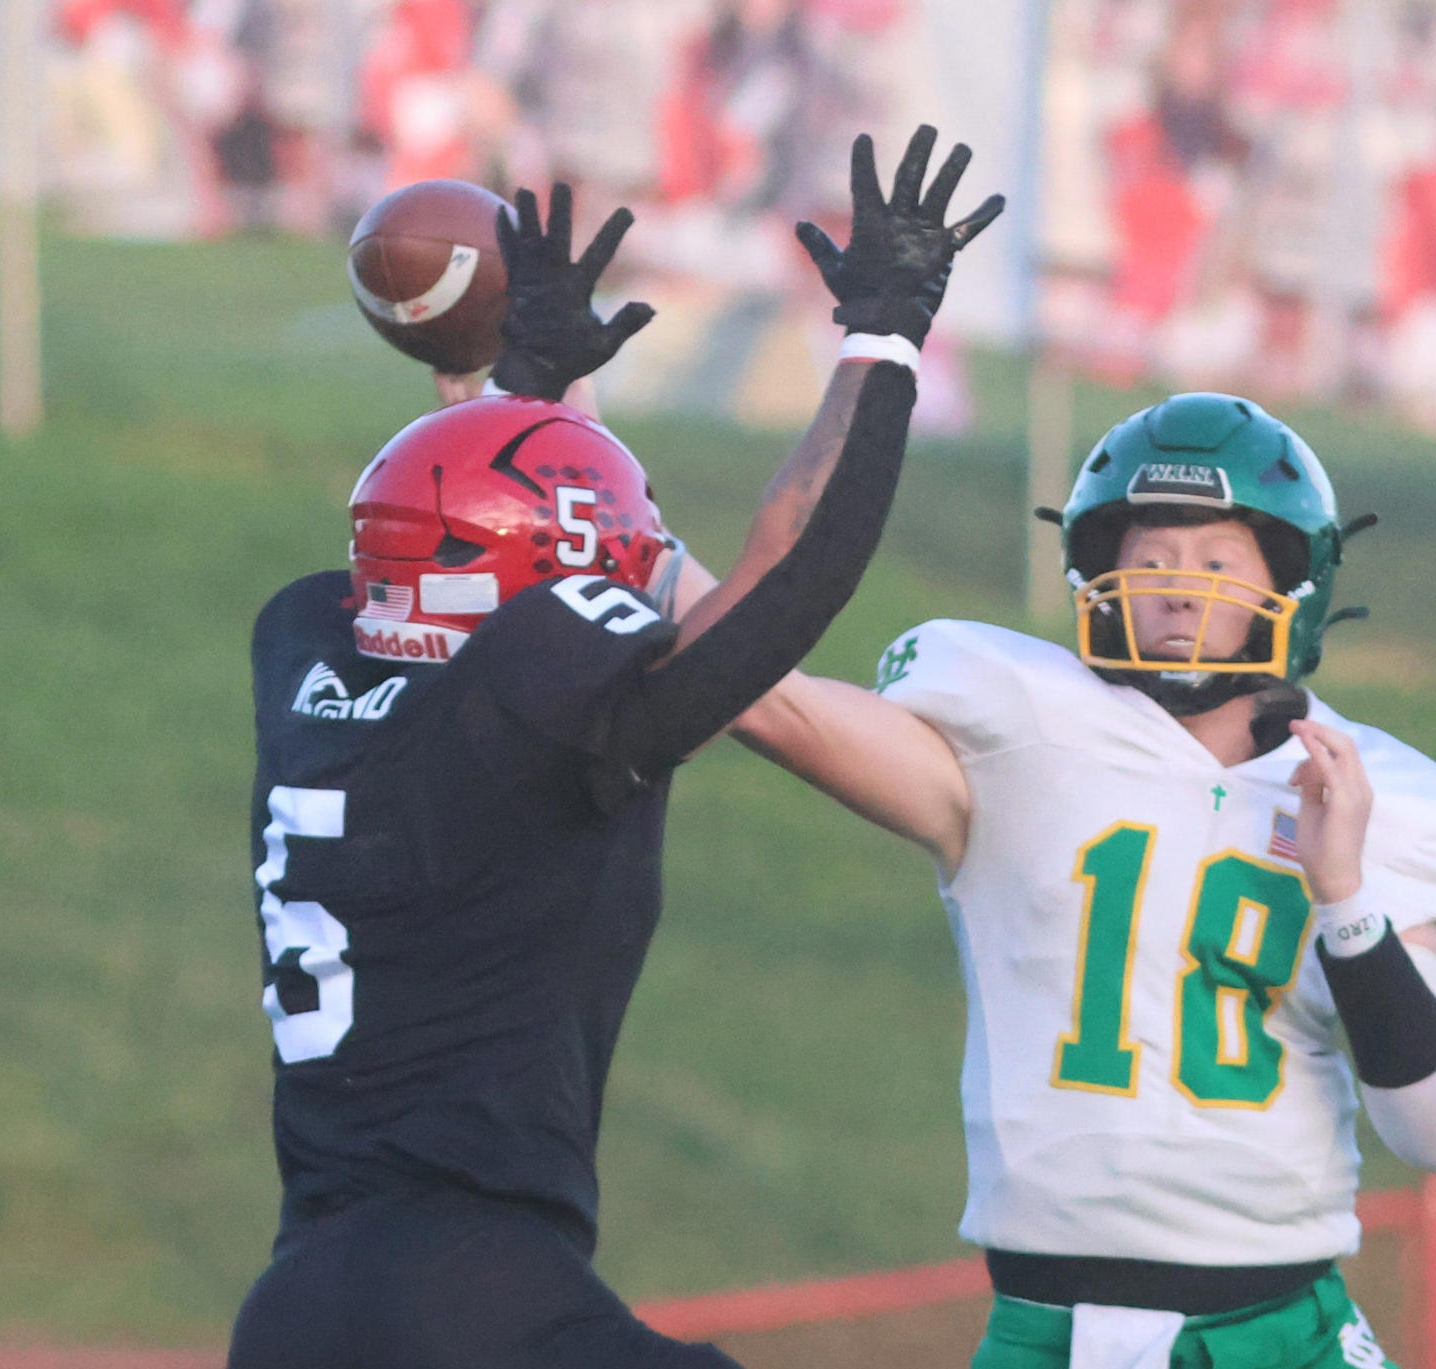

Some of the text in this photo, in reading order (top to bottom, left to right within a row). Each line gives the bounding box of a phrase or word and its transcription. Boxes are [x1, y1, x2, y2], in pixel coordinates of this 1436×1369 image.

[550, 574, 661, 634] 5
[556, 485, 597, 568] 5
[255, 785, 355, 1065] 5
[1049, 818, 1315, 1111] 18
